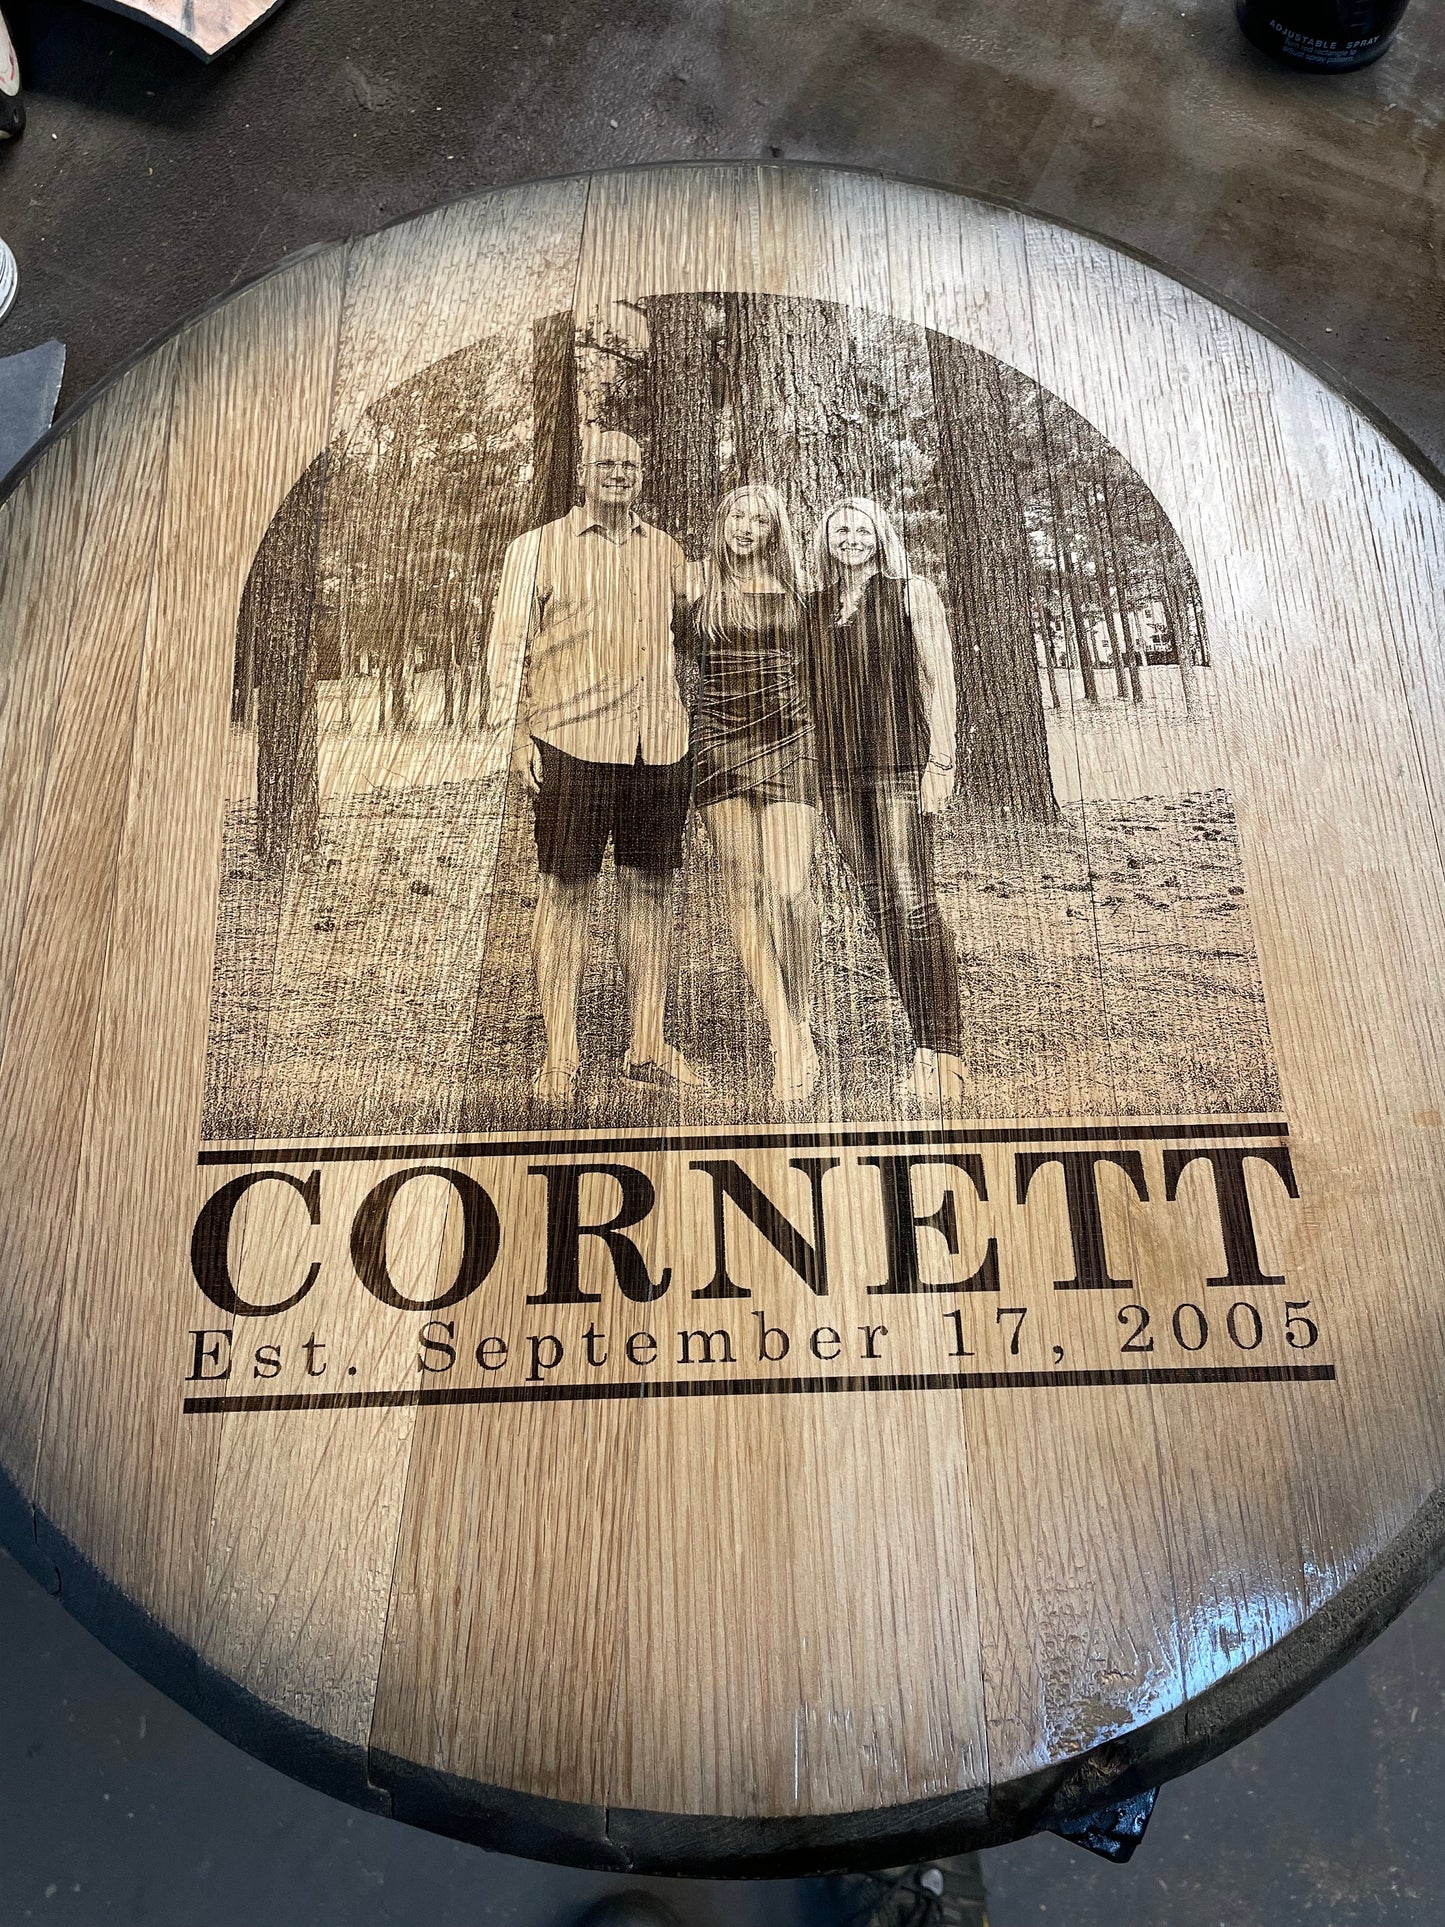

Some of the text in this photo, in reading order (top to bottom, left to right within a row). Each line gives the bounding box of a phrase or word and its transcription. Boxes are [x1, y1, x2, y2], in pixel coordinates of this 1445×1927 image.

[1268, 19, 1381, 50] ADJUSTABLE SPRAY
[190, 1147, 1301, 1317] CORNETT
[184, 1300, 1320, 1381] Est. September 17, 2005
